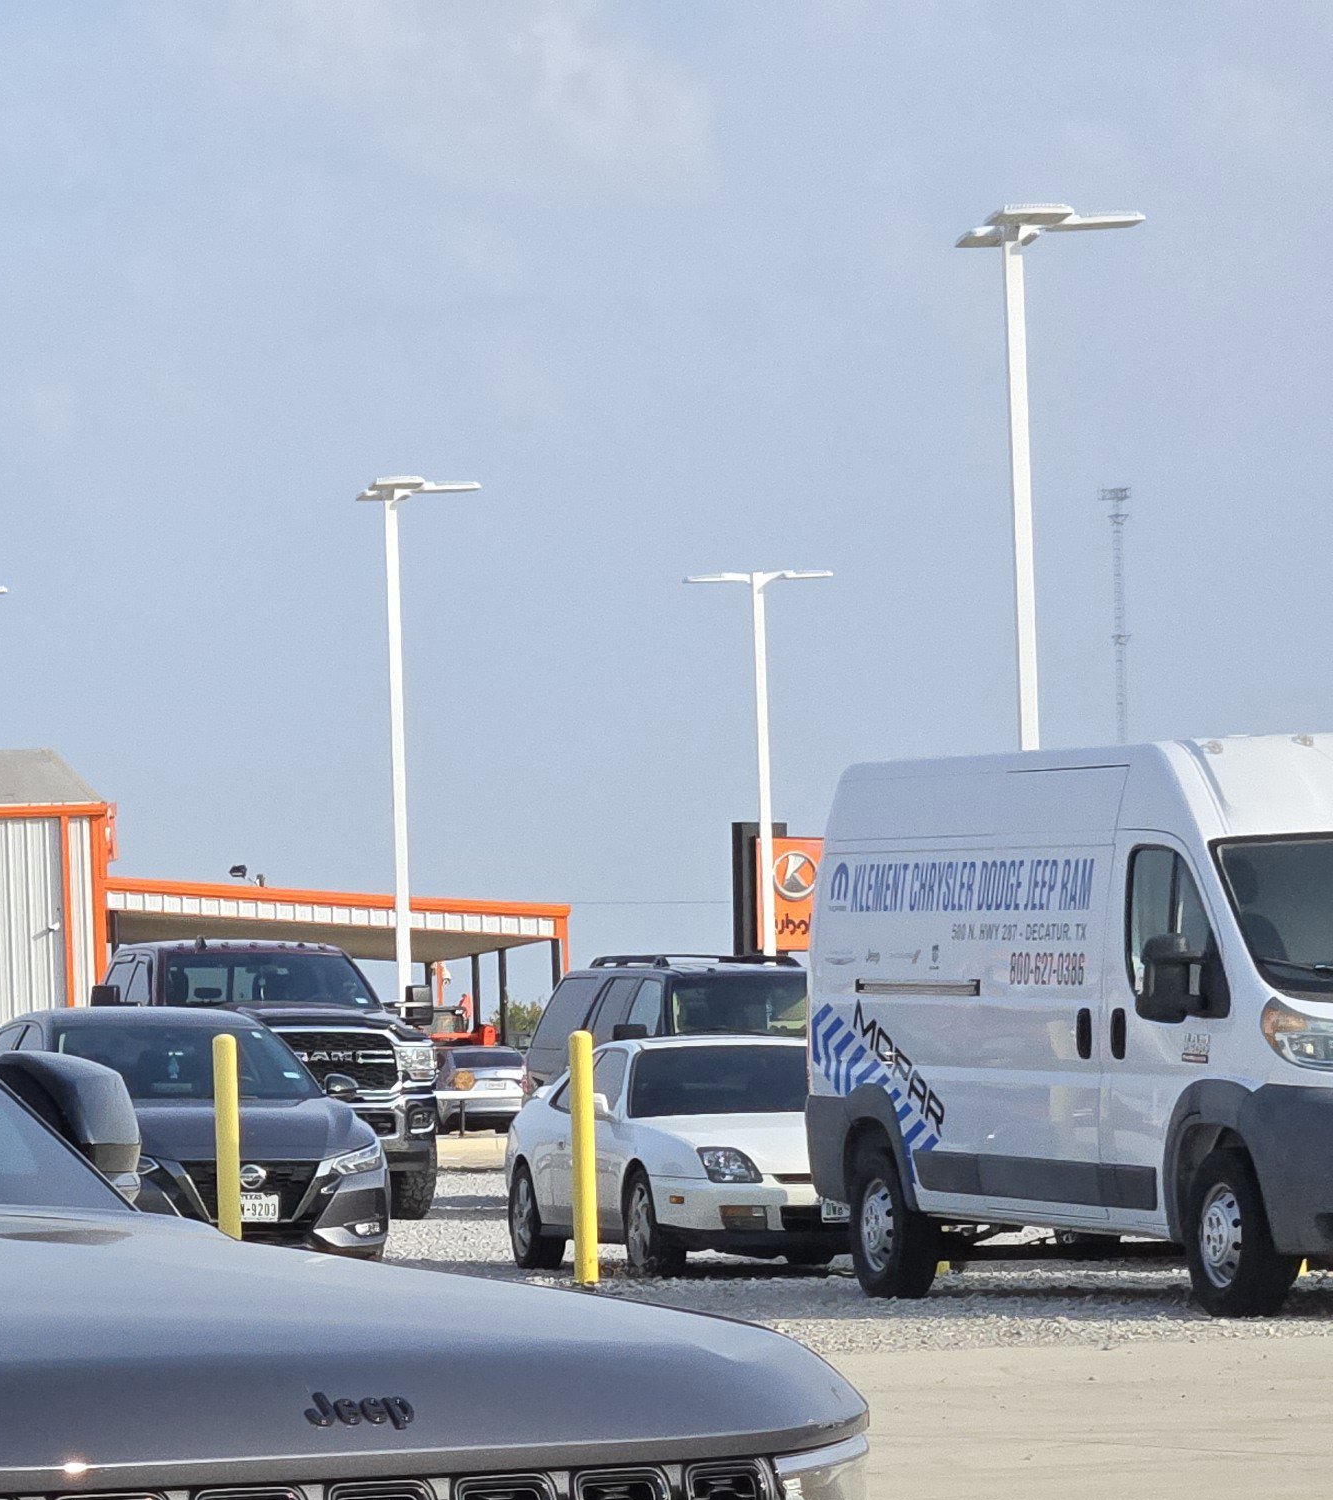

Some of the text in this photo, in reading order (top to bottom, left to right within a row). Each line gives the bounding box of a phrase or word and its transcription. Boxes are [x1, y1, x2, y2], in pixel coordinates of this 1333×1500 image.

[850, 858, 1095, 912] KLEMENT CHRYSLER DODGE JEEP RAM
[979, 923, 1000, 940] HWY
[1002, 923, 1018, 940] 287
[1075, 923, 1088, 940] TX
[1009, 951, 1086, 985] 800-627-0386
[853, 999, 945, 1138] MOPAR
[303, 1391, 415, 1431] Jeep
